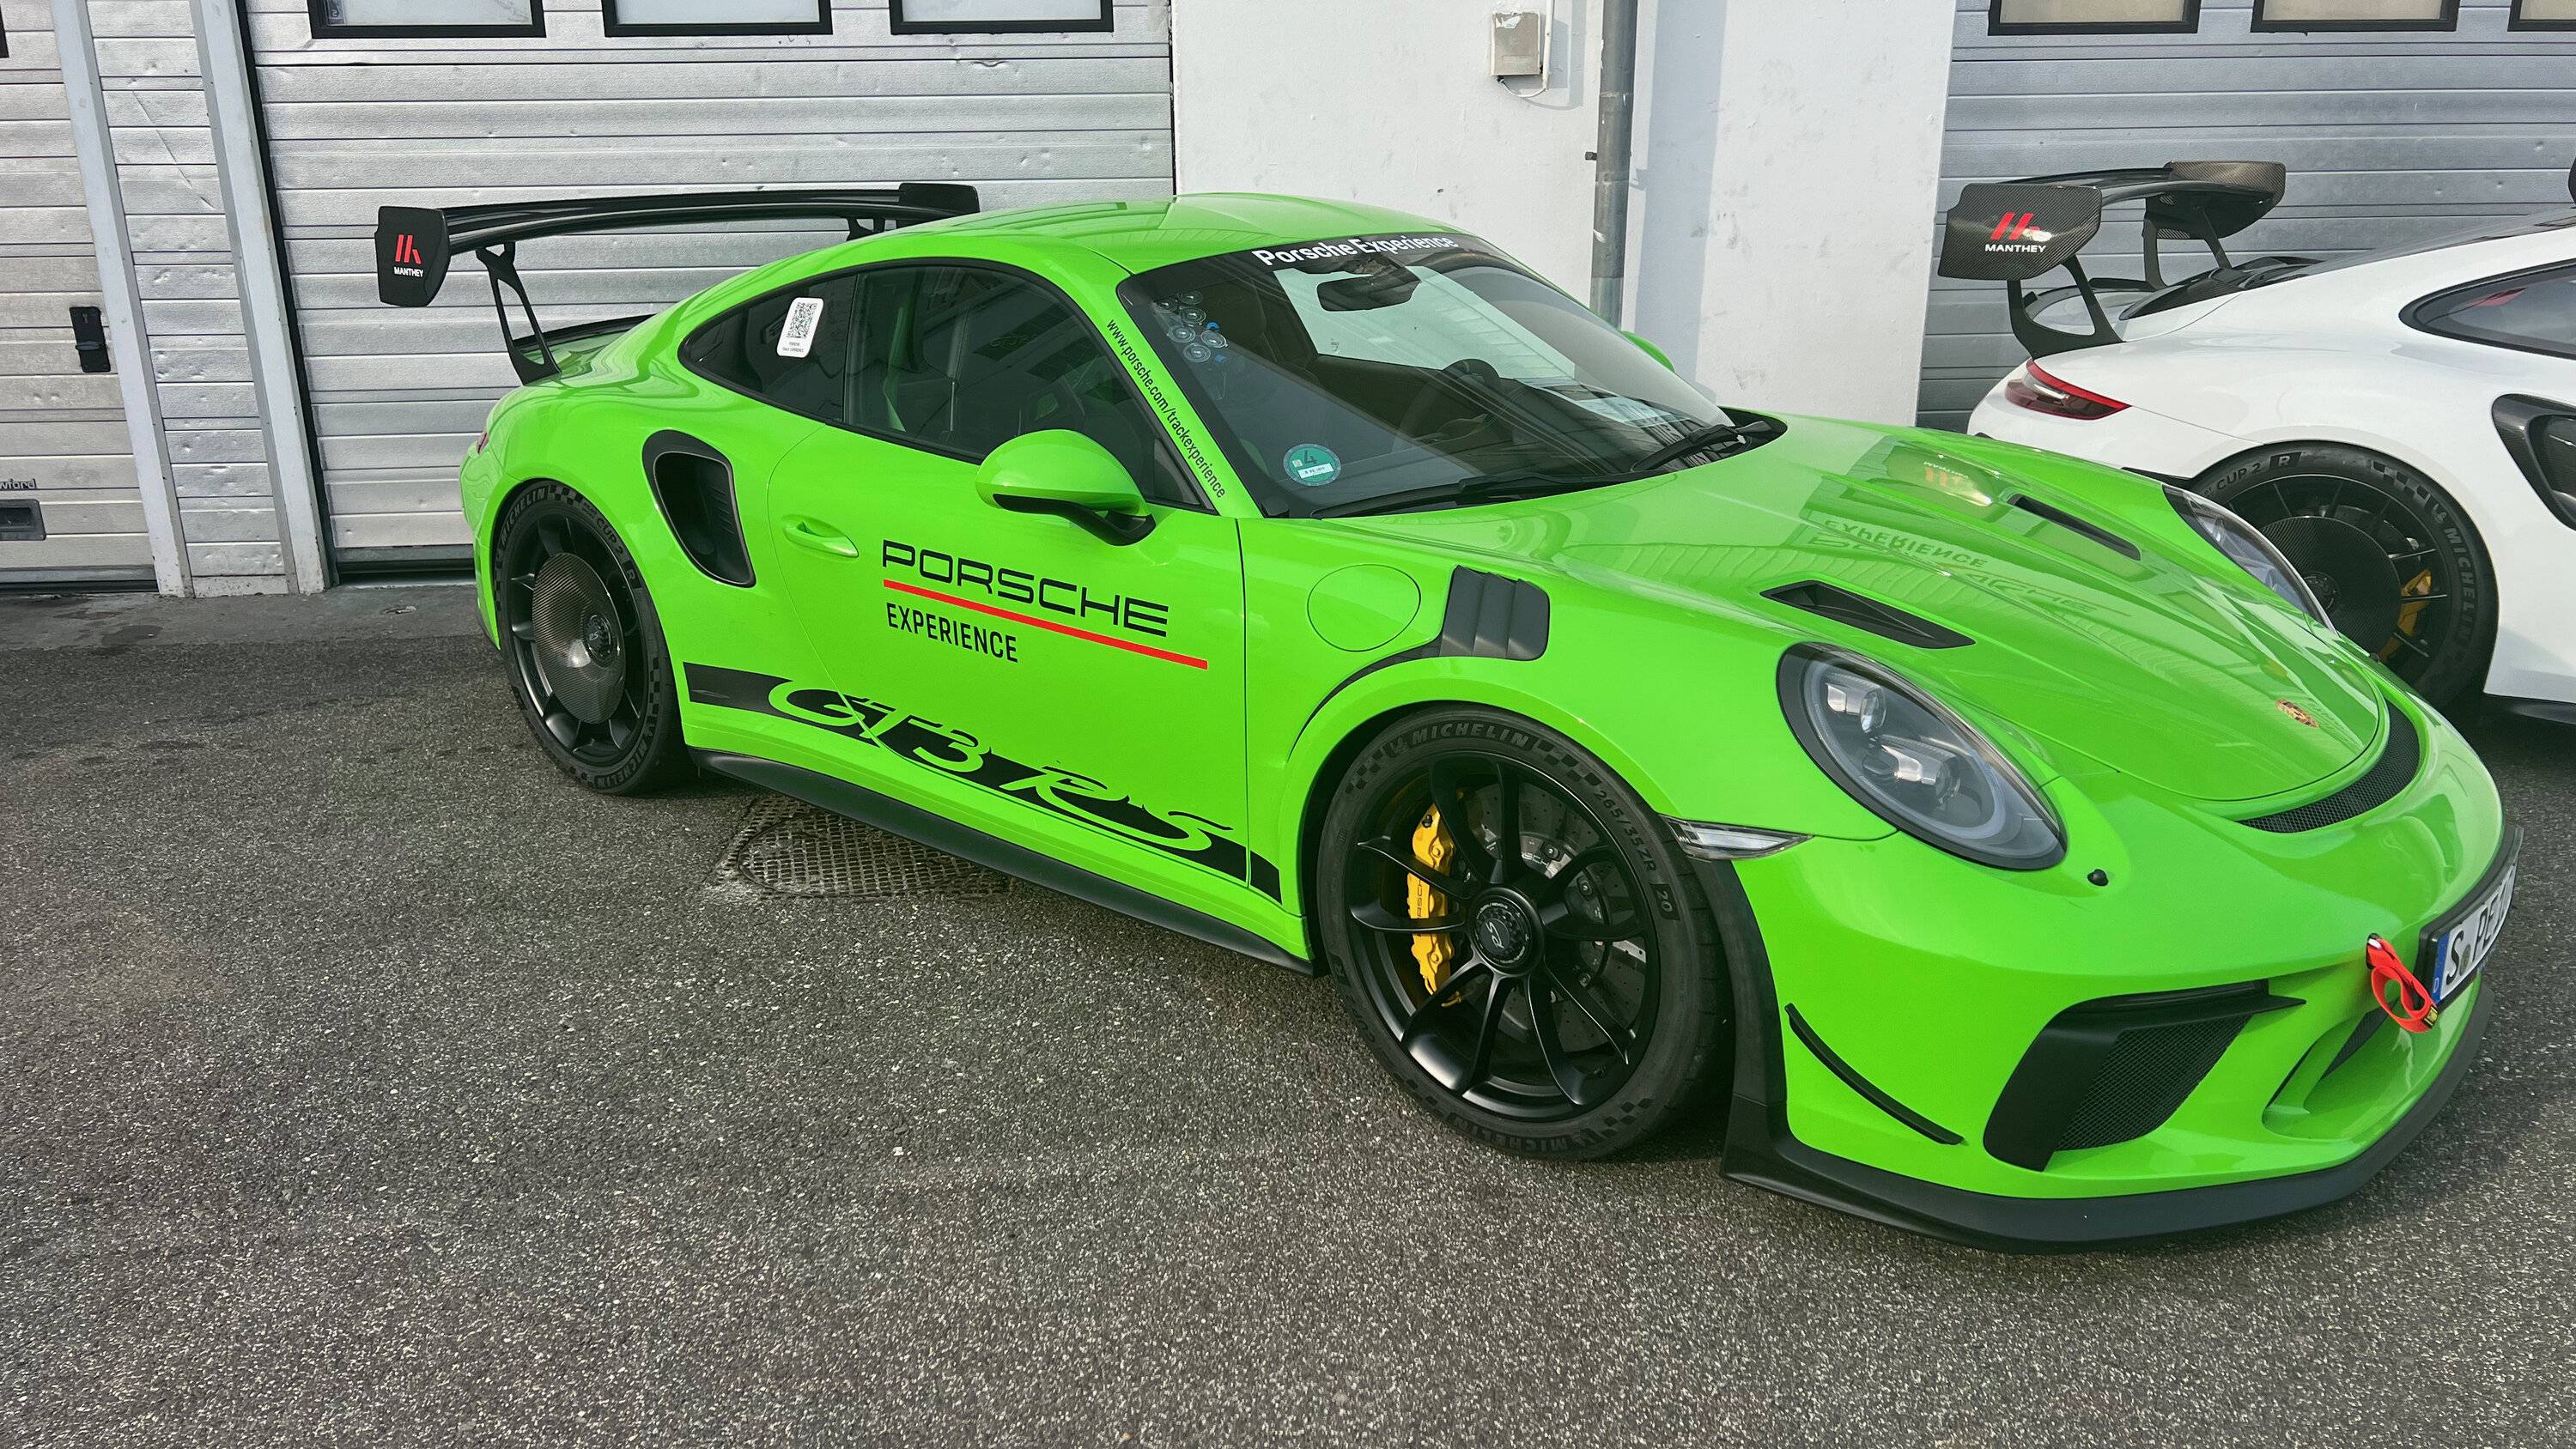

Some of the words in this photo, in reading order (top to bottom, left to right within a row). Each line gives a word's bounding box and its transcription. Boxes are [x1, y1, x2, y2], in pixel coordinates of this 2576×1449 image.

[1251, 241, 1359, 266] Porsche
[1351, 234, 1459, 255] Experience
[1984, 244, 2046, 253] MANTHEY
[393, 266, 424, 277] MANTHEY
[1106, 318, 1225, 498] www.porsche.com/trackexperience
[2216, 467, 2248, 490] CUP
[2251, 462, 2262, 475] 2
[2278, 455, 2291, 467] R
[501, 487, 546, 549] MICHELIN
[882, 539, 1170, 638] PORSCHE
[2444, 526, 2476, 640] MICHELIN
[885, 602, 1018, 664] EXPERIENCE
[1413, 723, 1529, 749] MICHELIN
[769, 681, 991, 773] GT3
[999, 760, 1234, 851] RS
[1656, 889, 1674, 913] 20
[1485, 921, 1506, 949] RS
[2445, 930, 2464, 985] S
